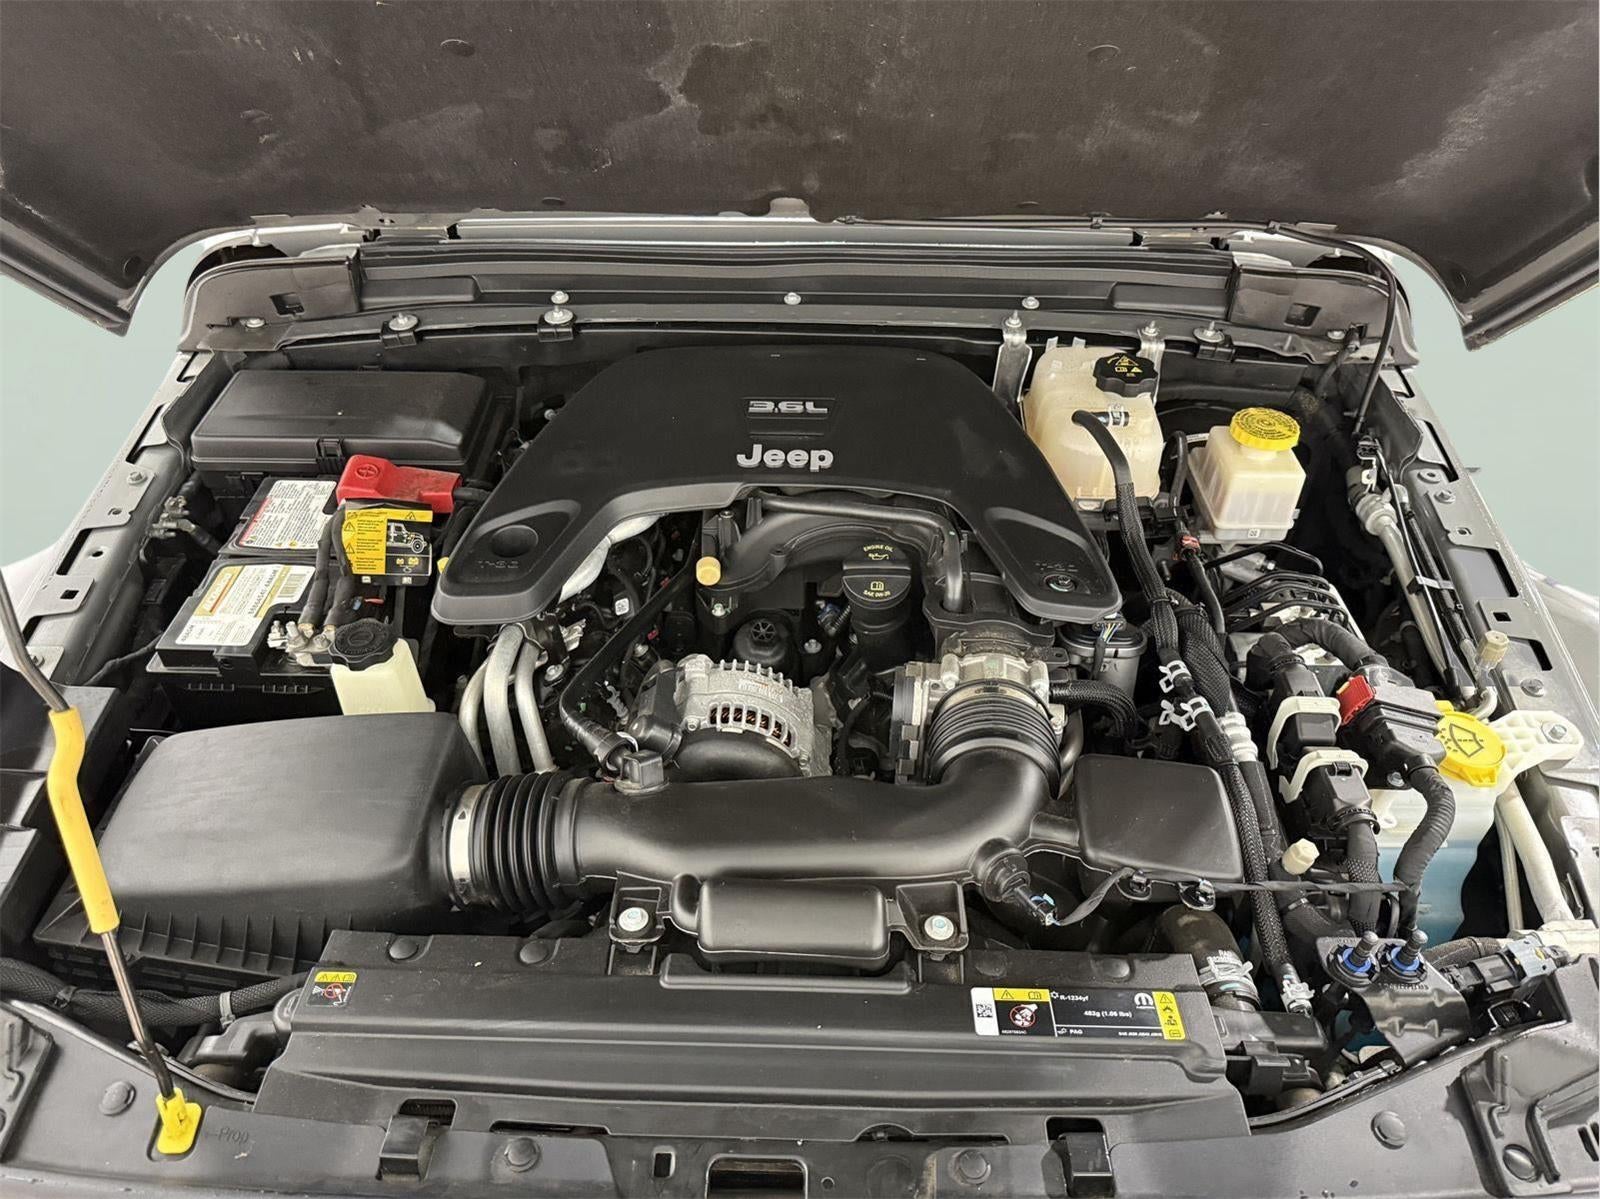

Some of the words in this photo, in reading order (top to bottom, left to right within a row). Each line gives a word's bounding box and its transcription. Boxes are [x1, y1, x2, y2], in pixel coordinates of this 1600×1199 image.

[748, 400, 829, 414] 3.6L
[736, 443, 833, 472] Jeep
[863, 544, 884, 552] ENGINE
[884, 545, 894, 553] OIL
[1059, 994, 1089, 1002] R-1234yf
